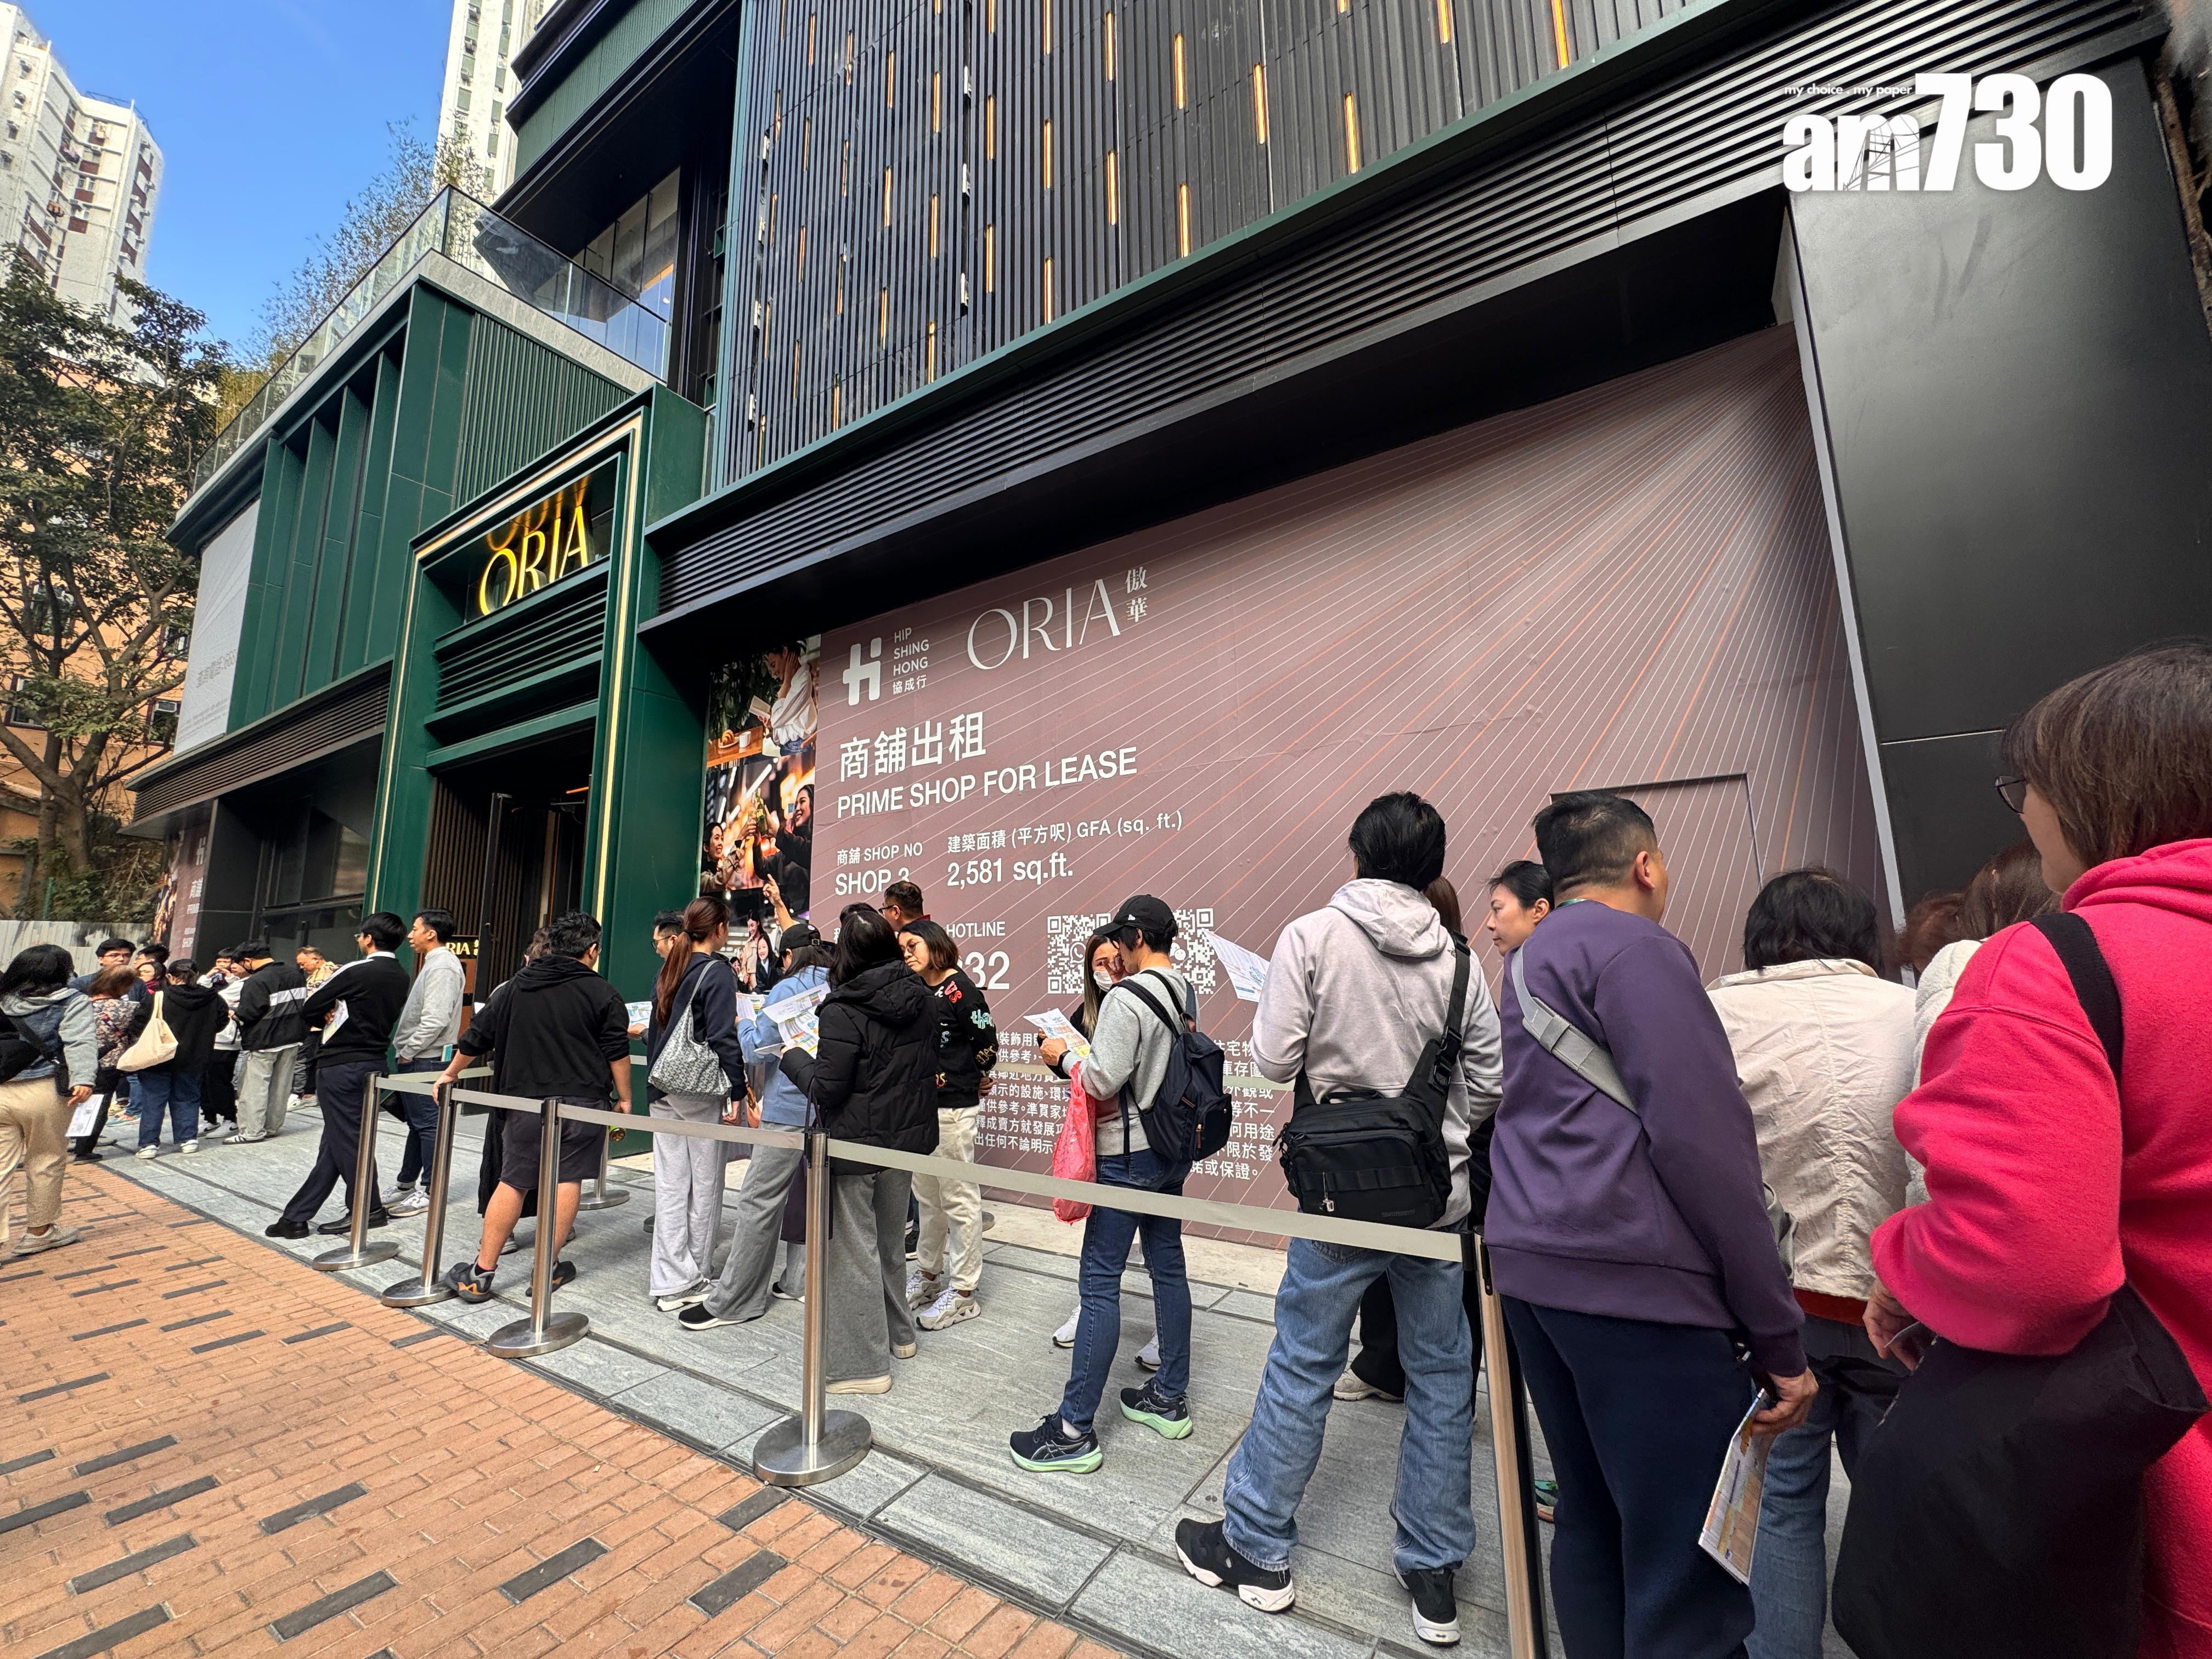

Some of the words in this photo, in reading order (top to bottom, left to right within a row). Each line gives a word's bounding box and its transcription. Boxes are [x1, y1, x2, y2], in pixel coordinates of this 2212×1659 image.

[479, 506, 589, 616] ORIA
[1124, 566, 1148, 623] 傲華
[894, 627, 912, 644] HIP
[967, 578, 1121, 670] ORIA
[893, 639, 929, 660] SHING
[893, 657, 928, 676] HONG
[892, 674, 927, 695] 協成行
[840, 711, 986, 782] 商舖出租
[838, 786, 904, 819] PRIME
[910, 775, 976, 808] SHOP
[984, 764, 1036, 796] FOR
[1045, 746, 1138, 787] LEASE
[947, 829, 1007, 854] 建築面積
[1076, 819, 1111, 838] GFA
[1117, 817, 1150, 837] (sq.
[1156, 810, 1183, 831] ft.)
[837, 847, 861, 866] 商舖
[864, 845, 900, 862] SHOP
[904, 842, 923, 857] NO
[835, 868, 891, 896] SHOP
[947, 857, 1002, 890] 2,581
[1013, 852, 1074, 885] sq.ft.
[946, 921, 1006, 938] HOTLINE
[446, 942, 471, 955] RIA
[957, 951, 1011, 990] 32
[996, 1031, 1039, 1047] 裝飾用
[974, 1131, 1057, 1154] 出任何不論明示
